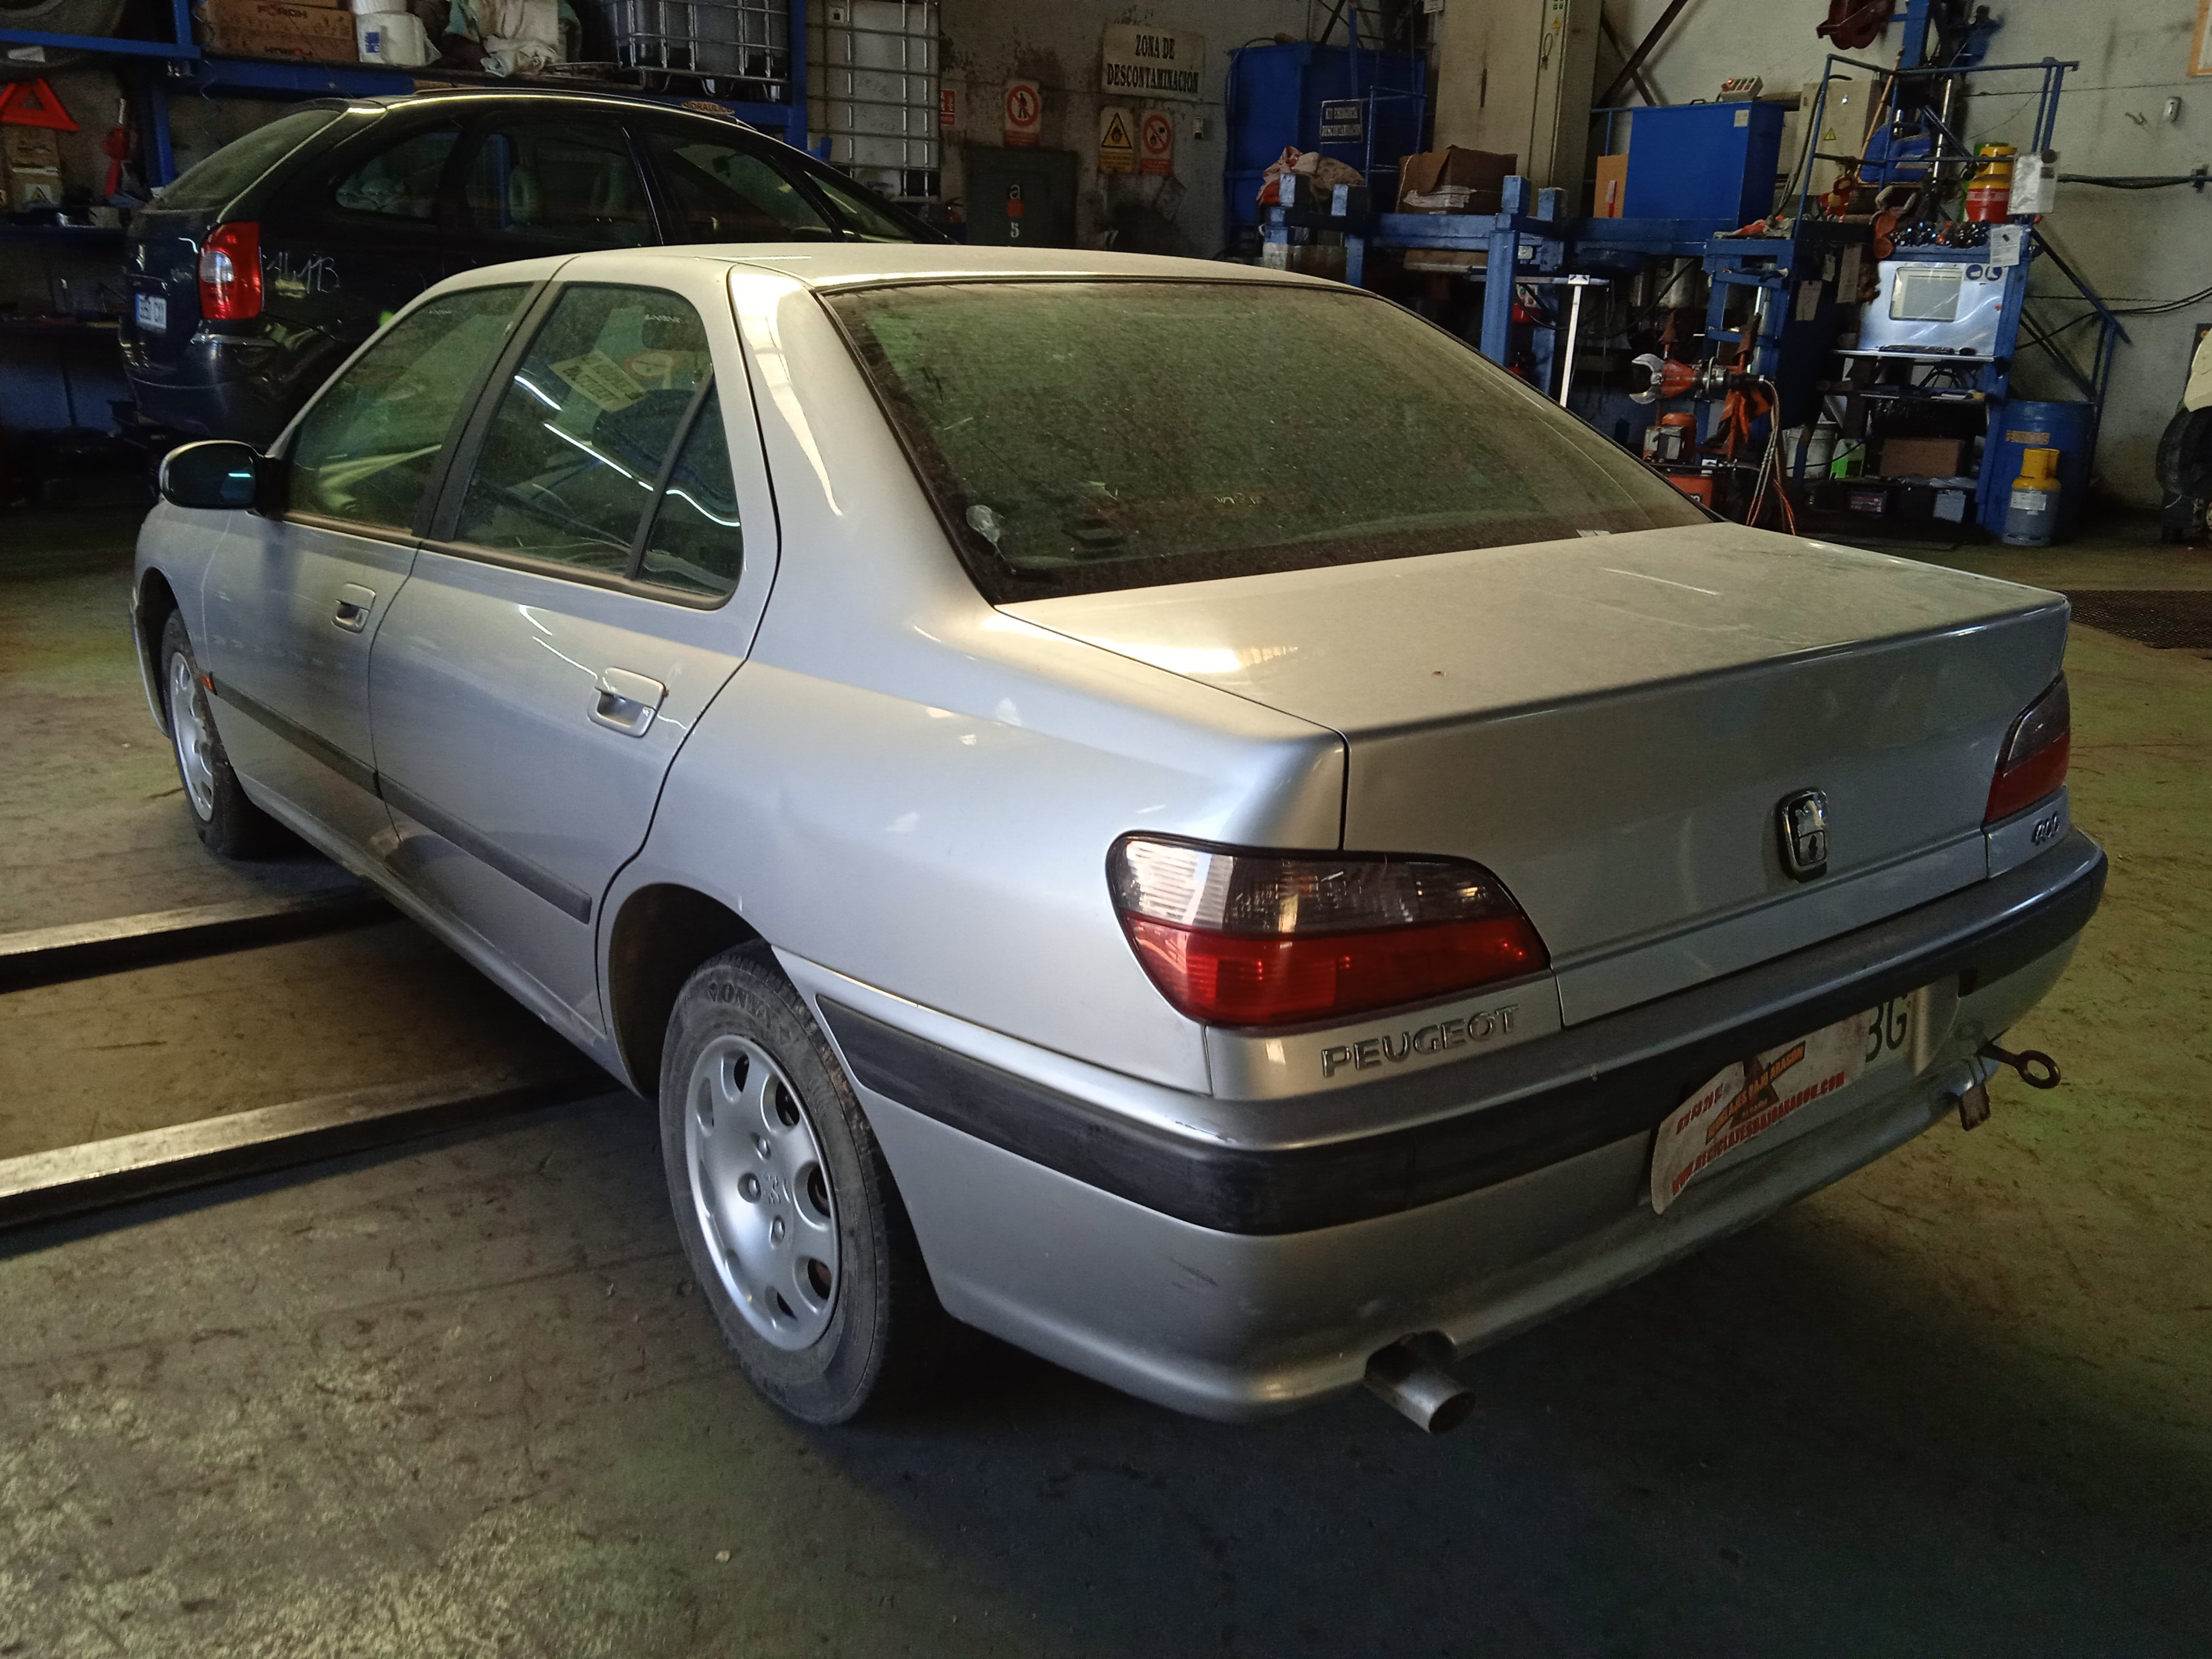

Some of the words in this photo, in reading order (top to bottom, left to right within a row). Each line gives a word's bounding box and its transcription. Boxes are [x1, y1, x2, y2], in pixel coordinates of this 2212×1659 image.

[1135, 34, 1160, 58] ZONA
[1162, 37, 1175, 60] DE
[1107, 63, 1199, 93] DESCONTAMINACIÓN
[1321, 1004, 1520, 1078] PEUGEOT
